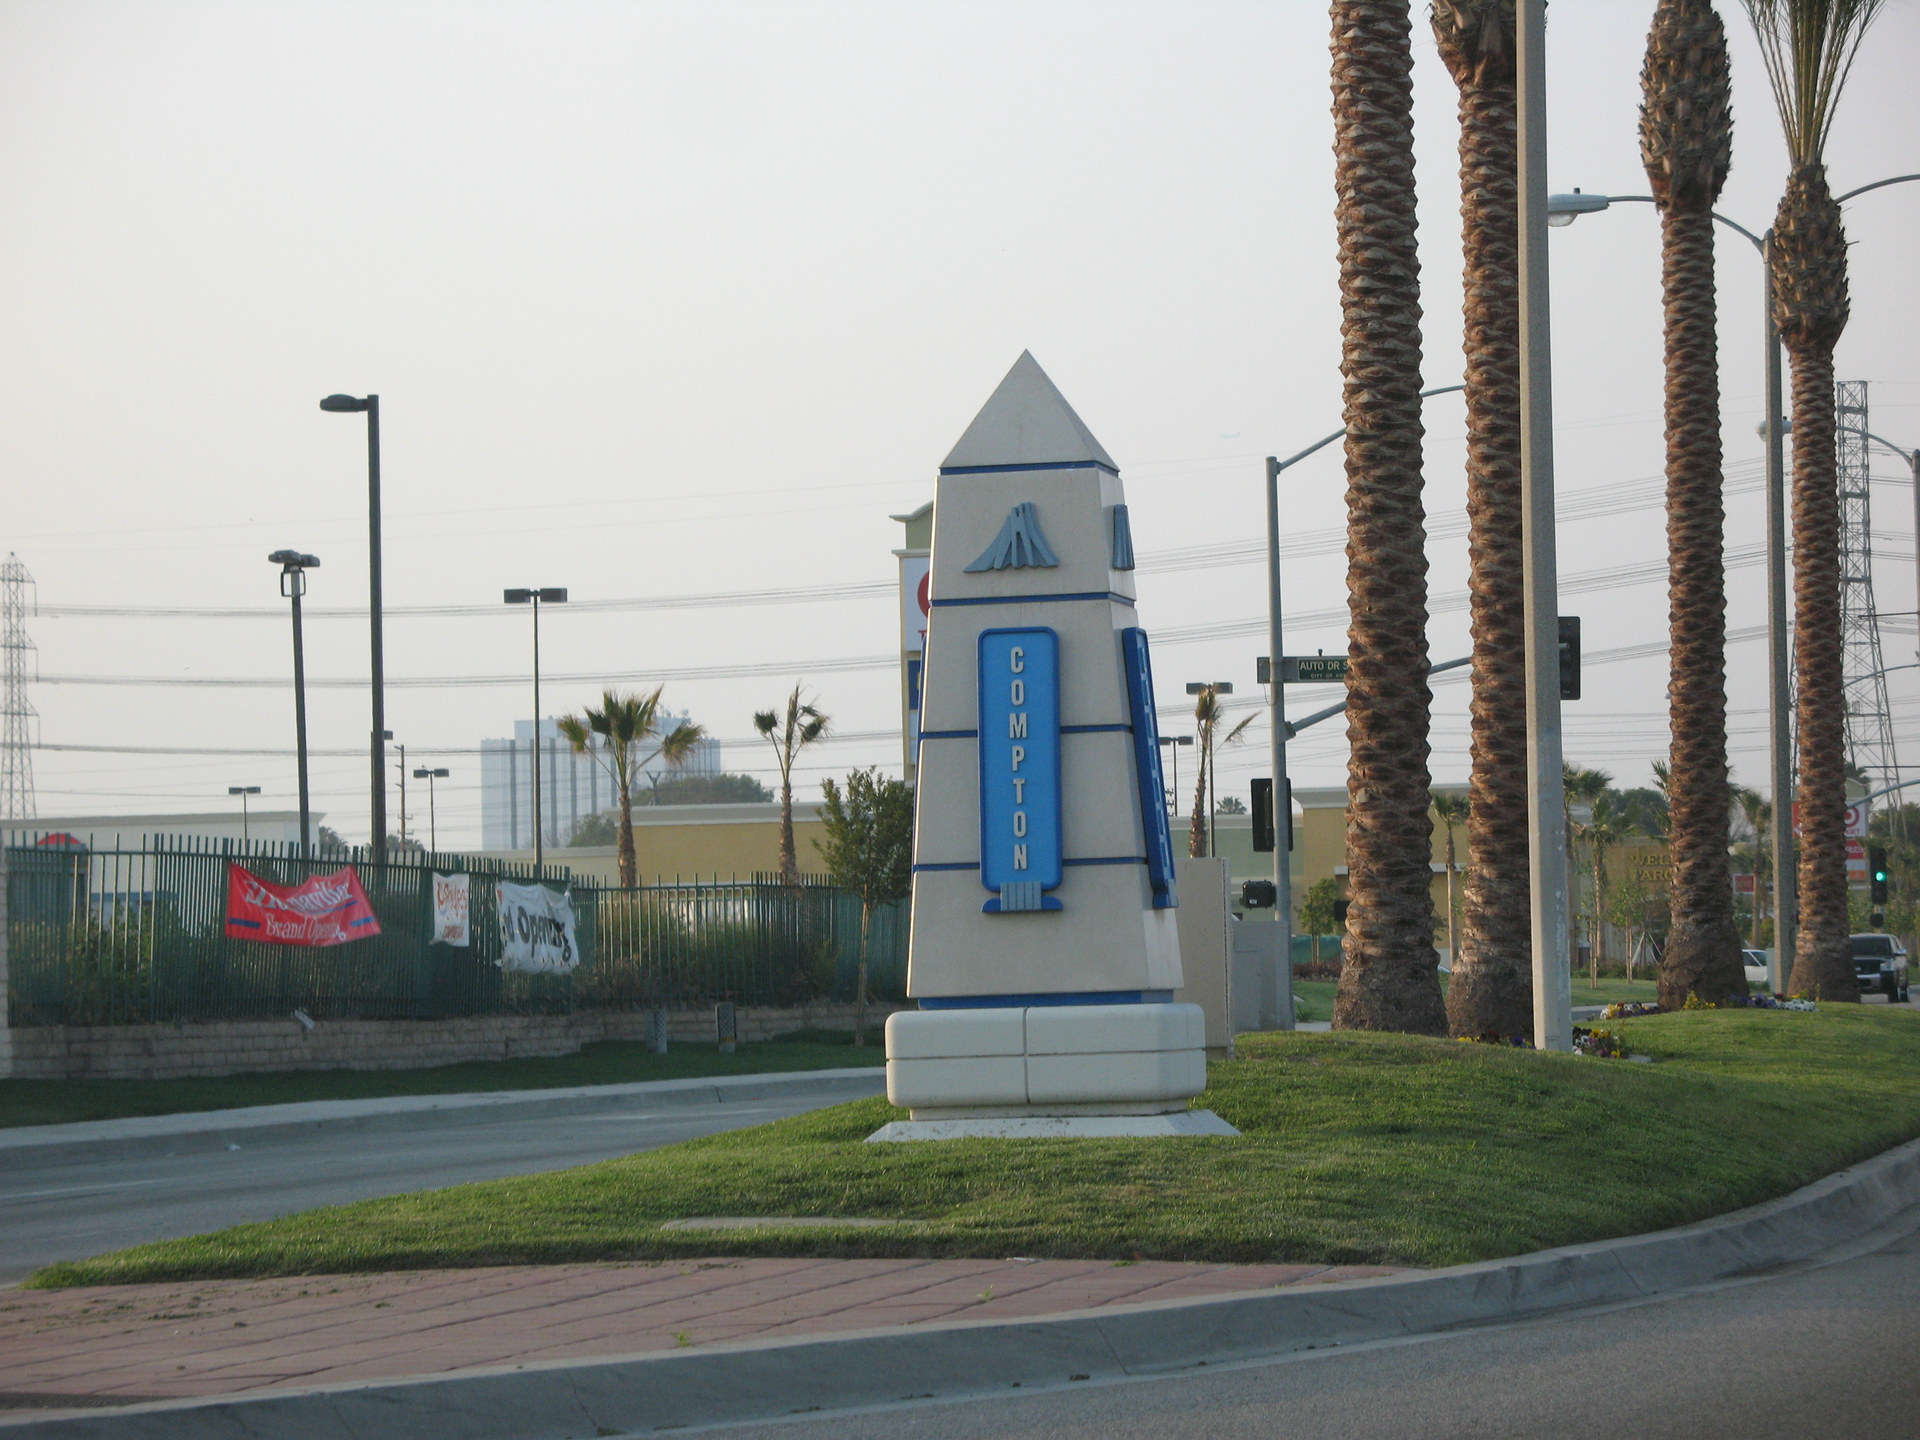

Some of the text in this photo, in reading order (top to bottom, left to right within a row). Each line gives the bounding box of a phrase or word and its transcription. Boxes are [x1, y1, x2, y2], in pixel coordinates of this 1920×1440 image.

[1300, 661, 1324, 670] AUTO
[1327, 661, 1340, 670] DR
[1009, 646, 1027, 870] COMPTON
